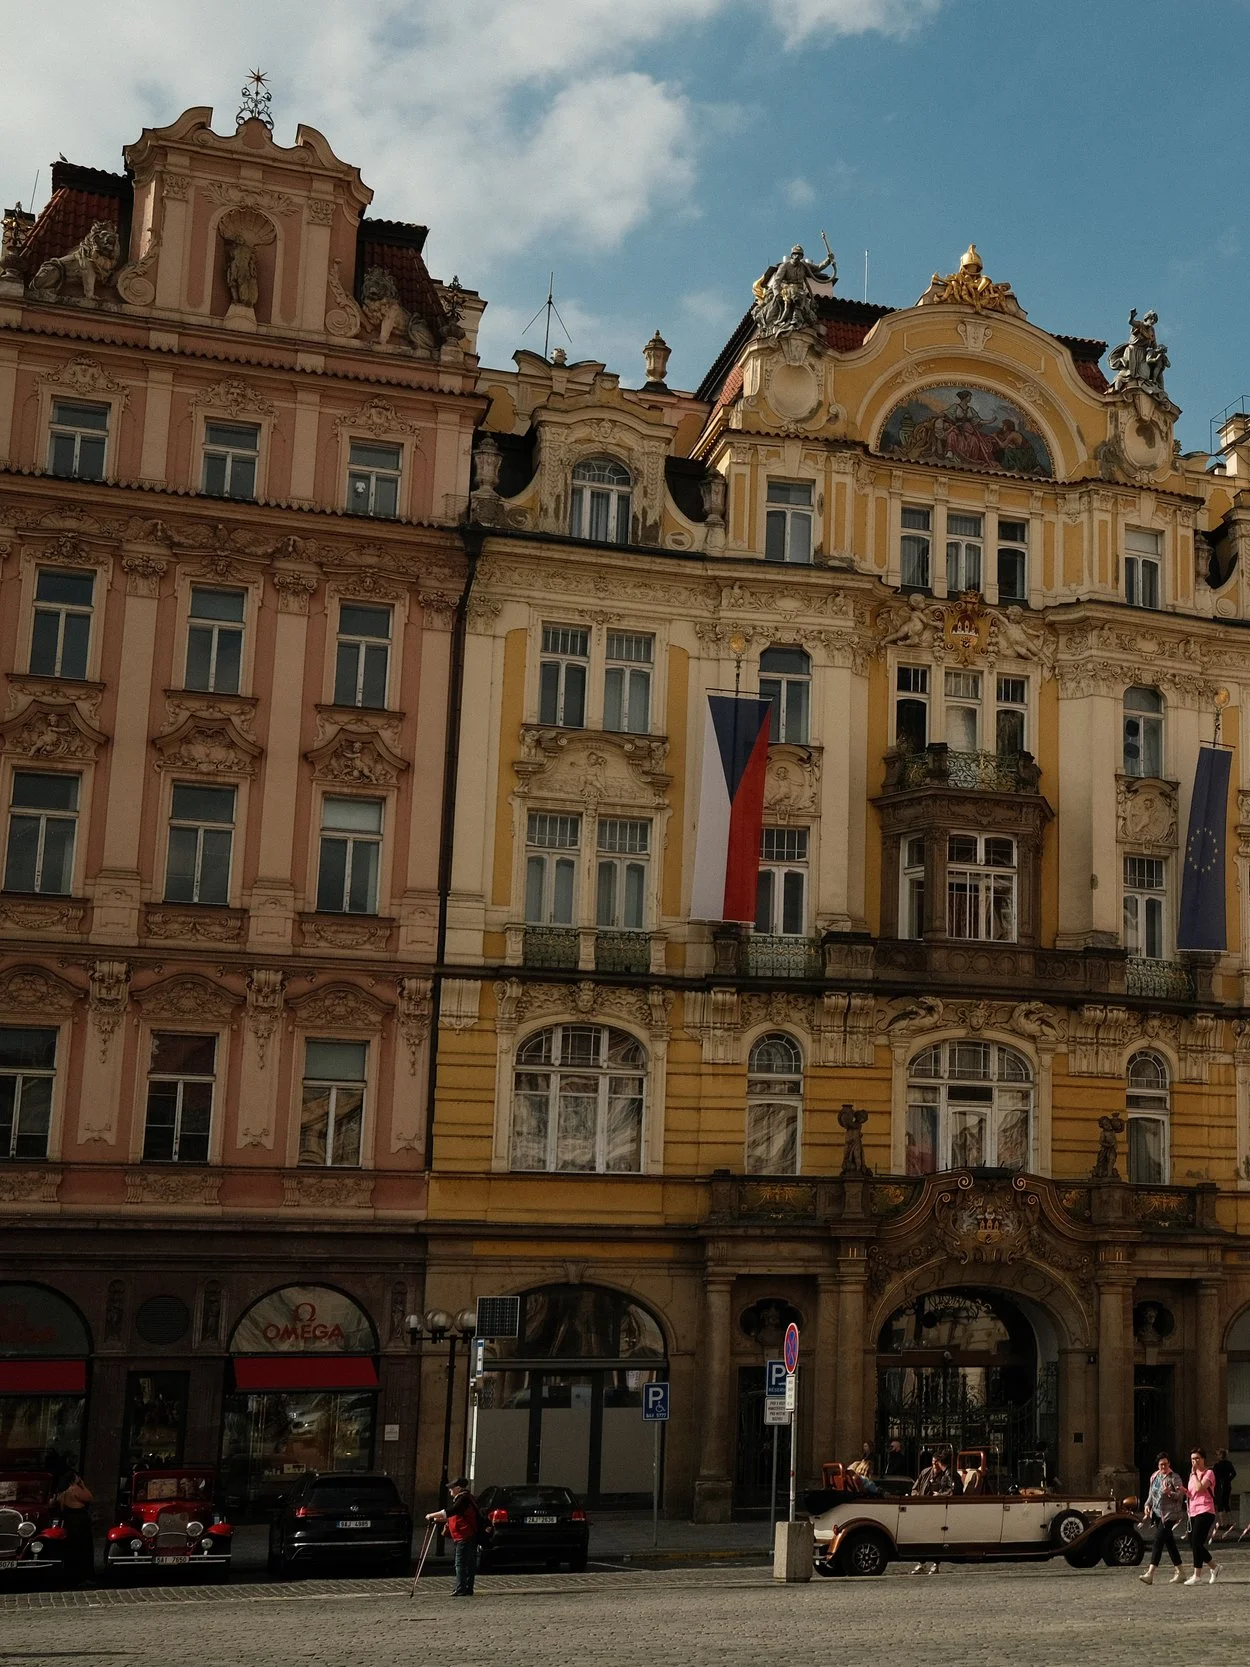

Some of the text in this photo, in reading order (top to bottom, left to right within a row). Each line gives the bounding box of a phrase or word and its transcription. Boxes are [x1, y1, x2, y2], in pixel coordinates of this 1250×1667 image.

[263, 1323, 344, 1341] OMEGA
[772, 1364, 786, 1385] P
[649, 1387, 664, 1409] P
